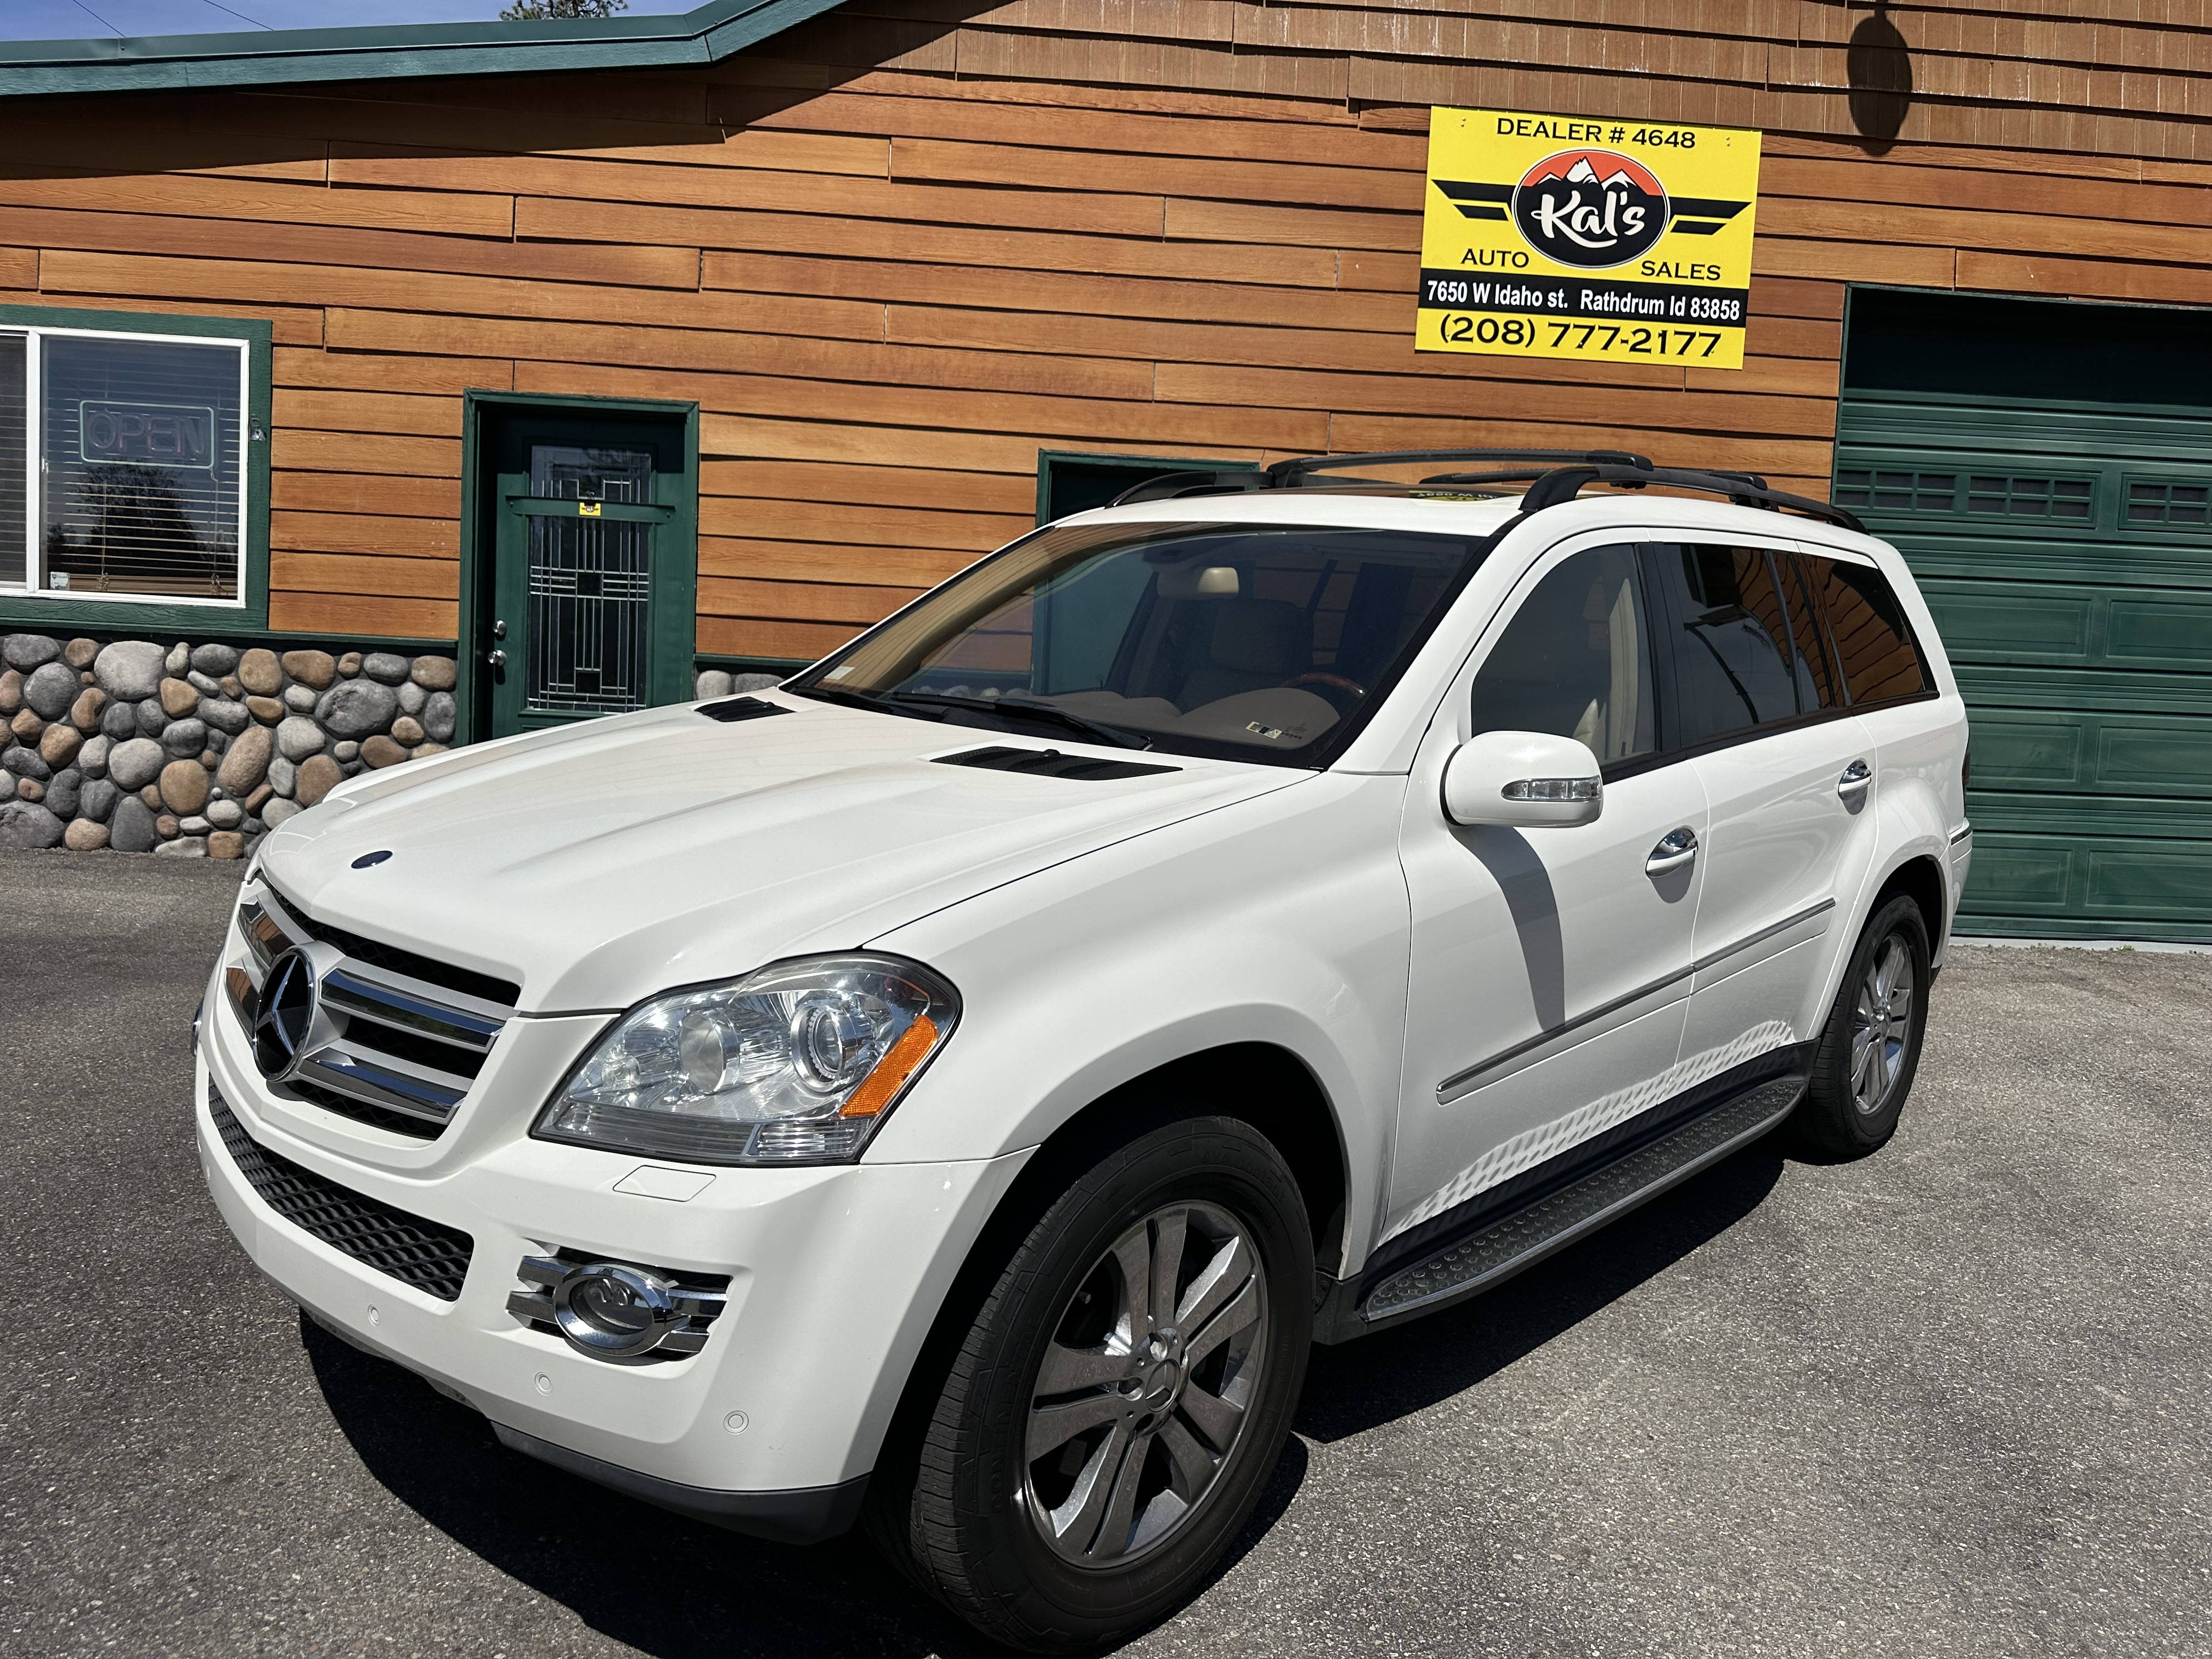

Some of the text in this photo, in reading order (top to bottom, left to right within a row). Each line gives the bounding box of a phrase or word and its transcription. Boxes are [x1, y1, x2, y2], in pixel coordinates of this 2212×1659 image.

[1496, 117, 1696, 149] DEALER # 4648
[1531, 189, 1646, 249] Kal's
[1460, 248, 1722, 281] AUTO SALES
[1427, 280, 1741, 321] 7650 W Idaho st. Rathdrum Id 83858
[1440, 313, 1722, 358] (208) 777-2177
[87, 413, 208, 456] OPEN
